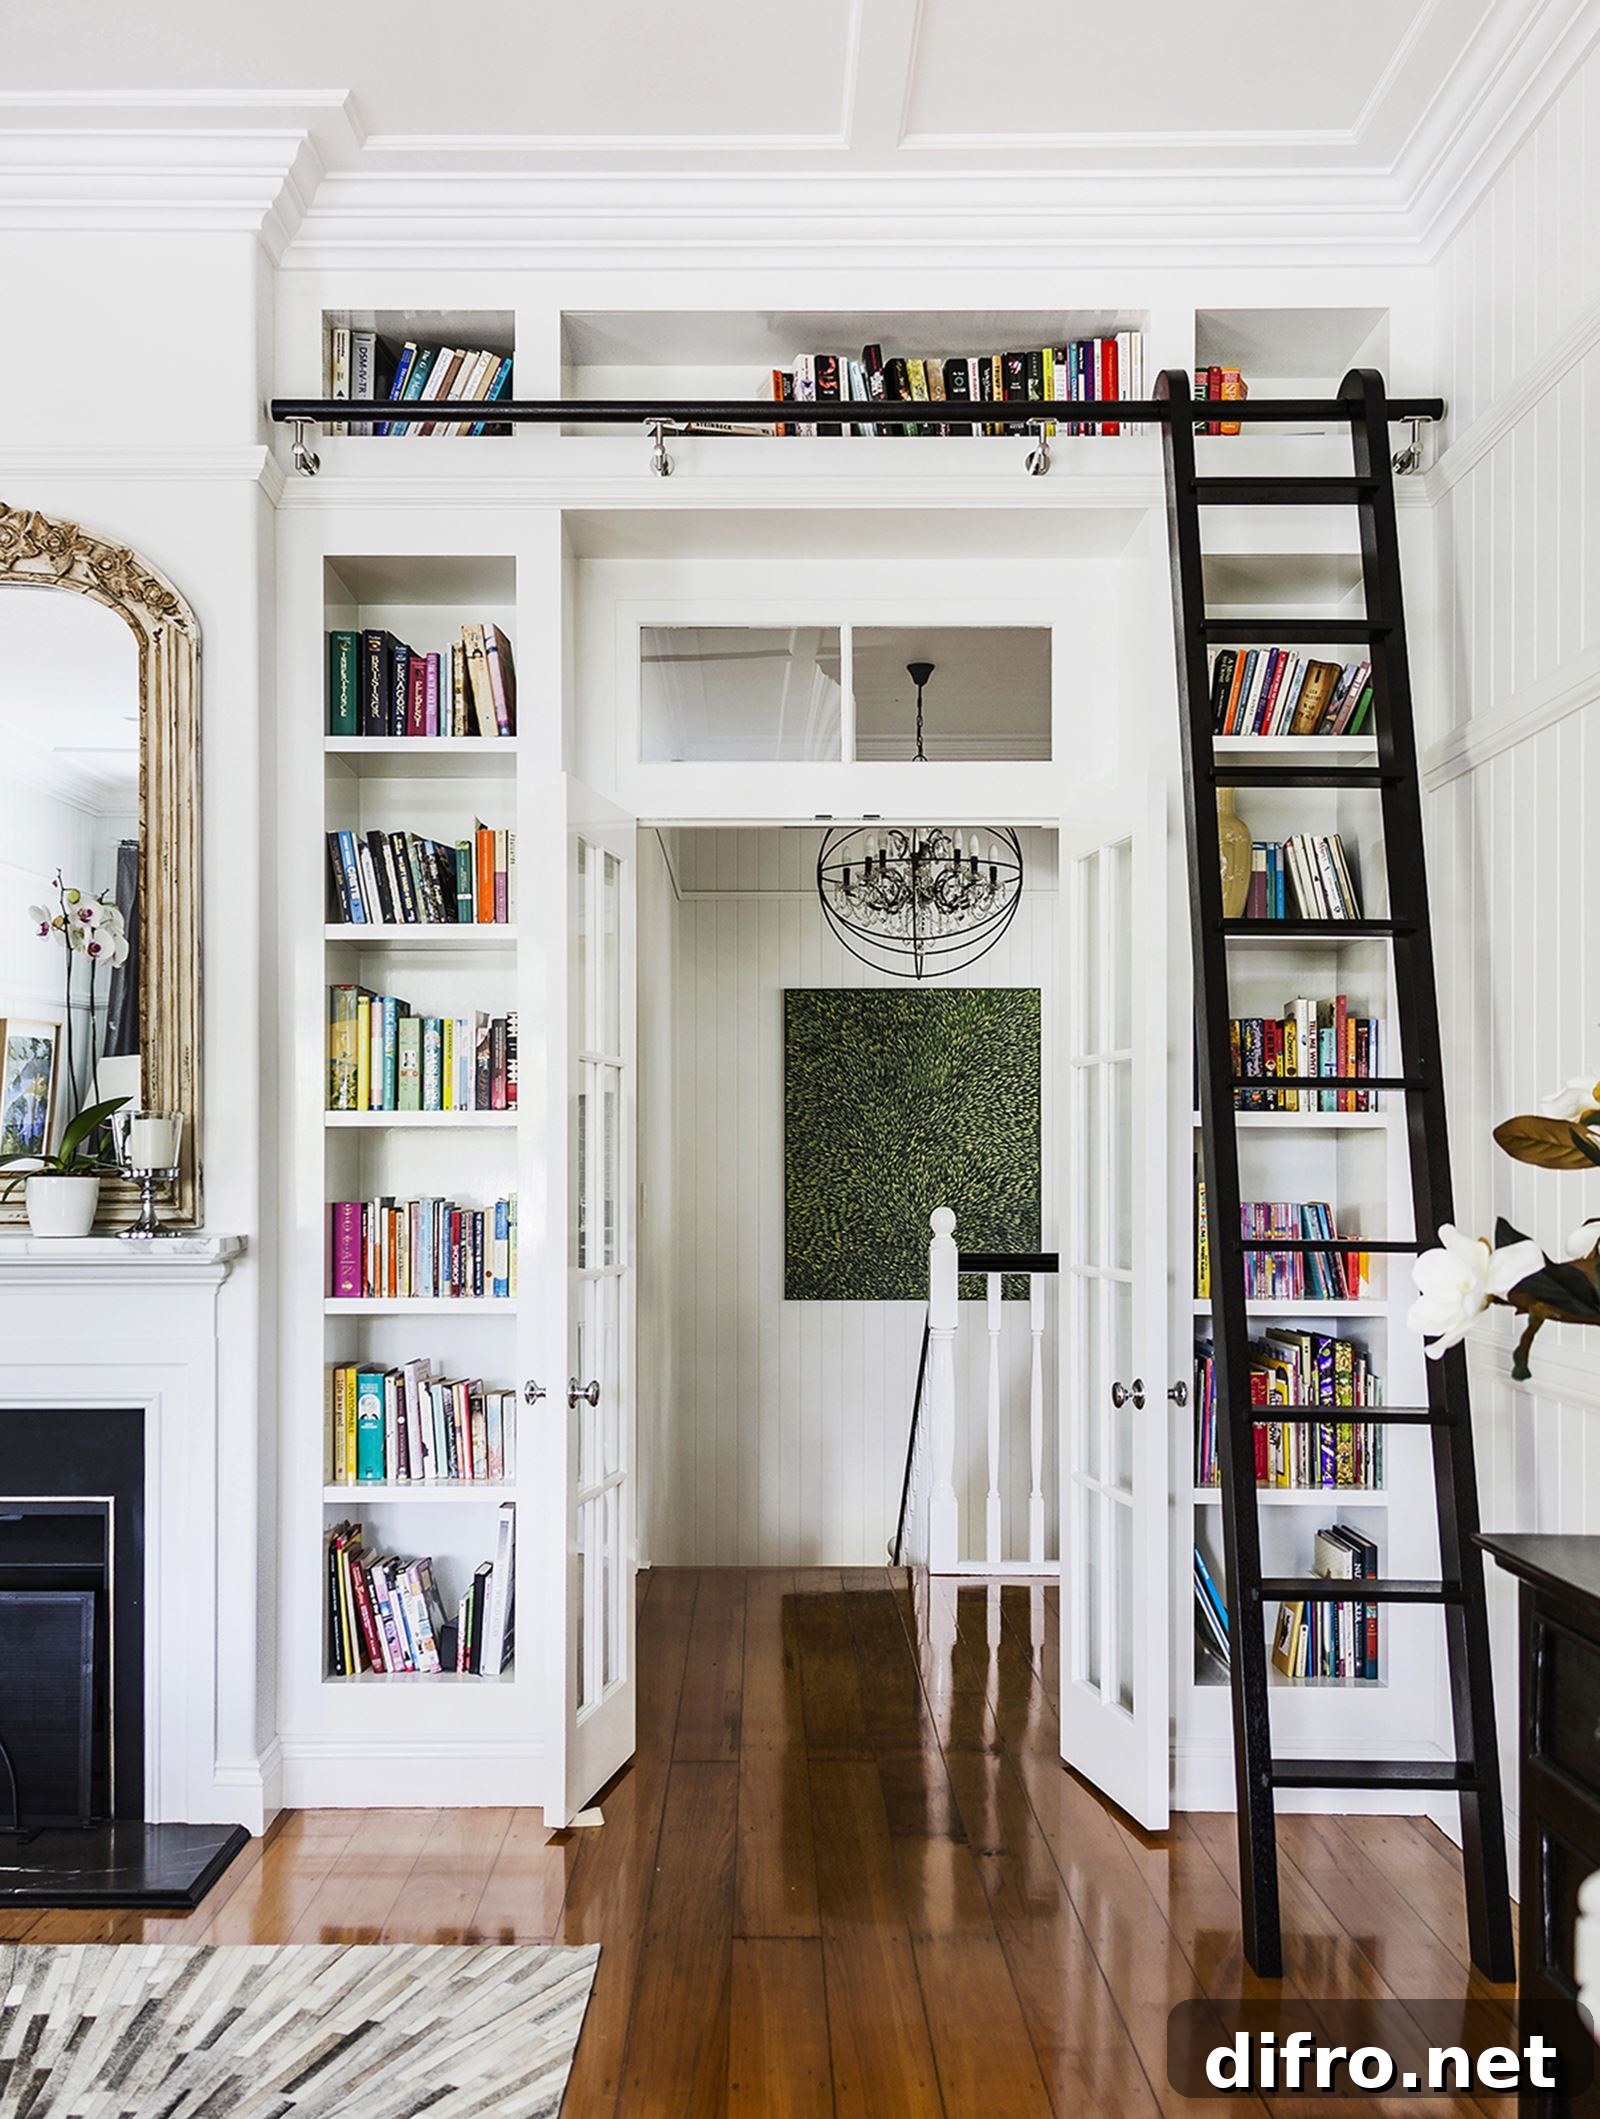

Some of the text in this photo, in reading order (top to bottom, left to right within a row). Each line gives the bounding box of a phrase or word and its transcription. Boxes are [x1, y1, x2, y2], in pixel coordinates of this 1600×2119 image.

[358, 347, 368, 394] DSM-IV-TR
[396, 664, 405, 716] ERAGON
[414, 681, 423, 727] ELDEST
[347, 866, 360, 900] CRETE
[385, 1001, 396, 1057] NICK HORNBY
[1310, 1038, 1316, 1048] ME
[336, 1412, 344, 1427] good
